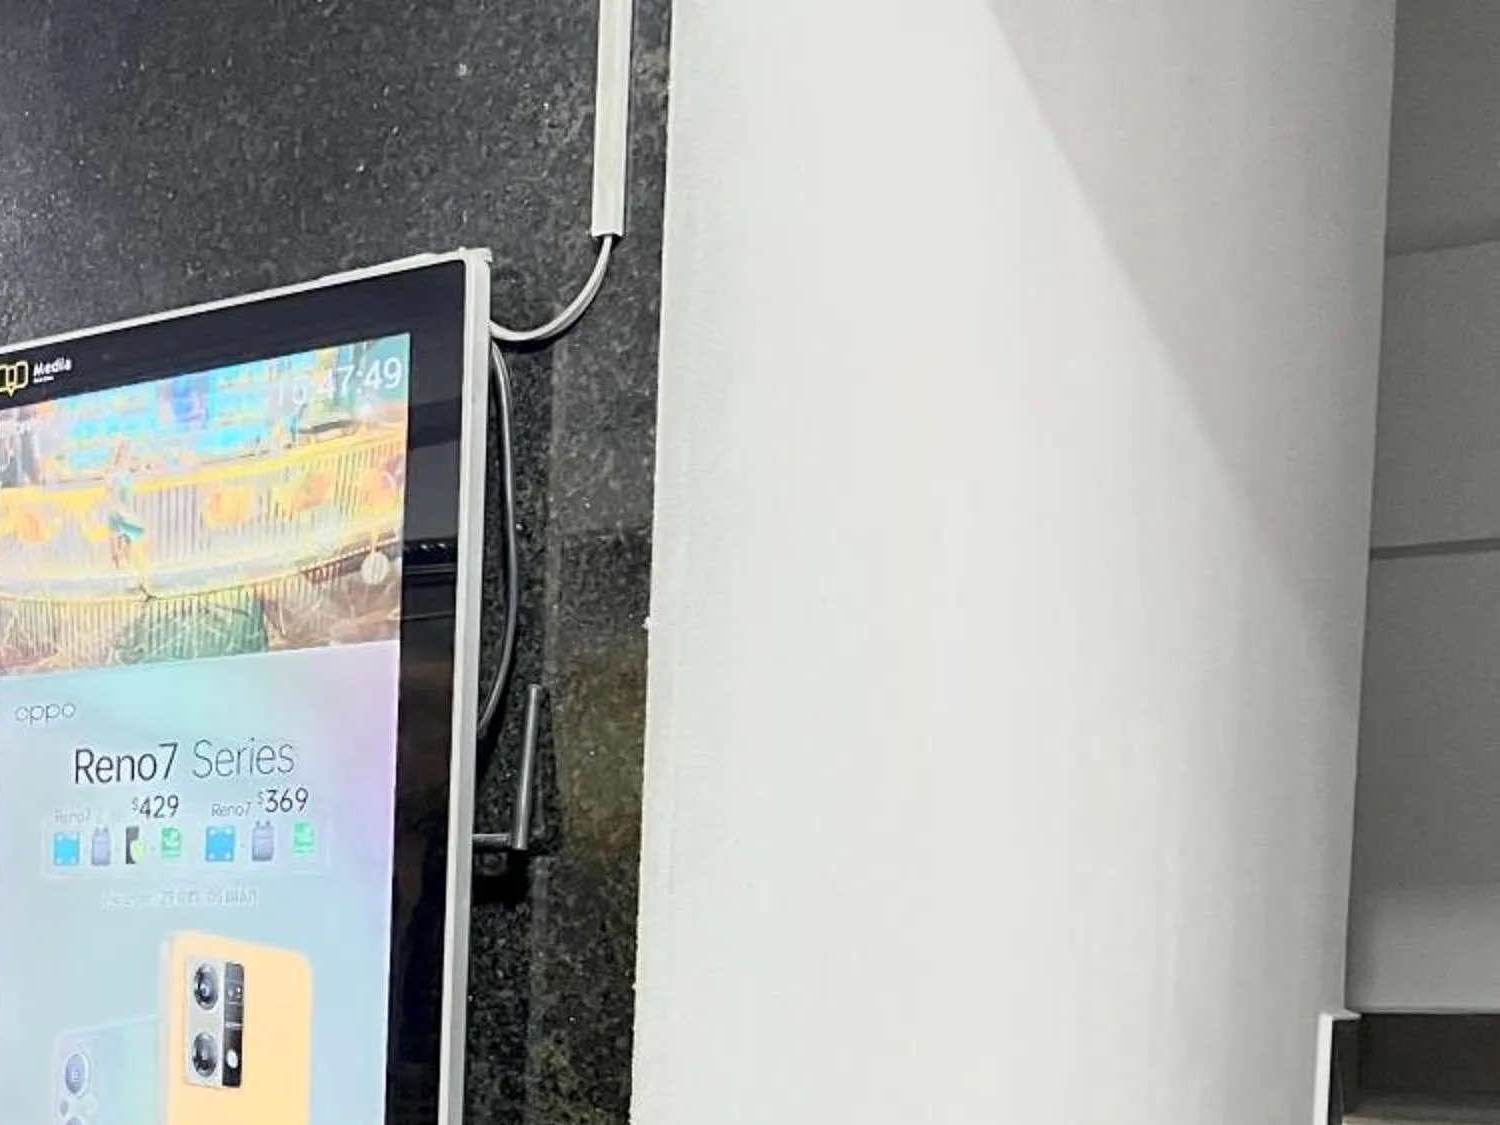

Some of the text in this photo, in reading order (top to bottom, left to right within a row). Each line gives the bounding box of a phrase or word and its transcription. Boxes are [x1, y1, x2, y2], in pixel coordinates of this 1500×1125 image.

[74, 738, 295, 785] Reno7 Series
[131, 794, 180, 820] $429
[211, 787, 309, 819] Reno7 $369
